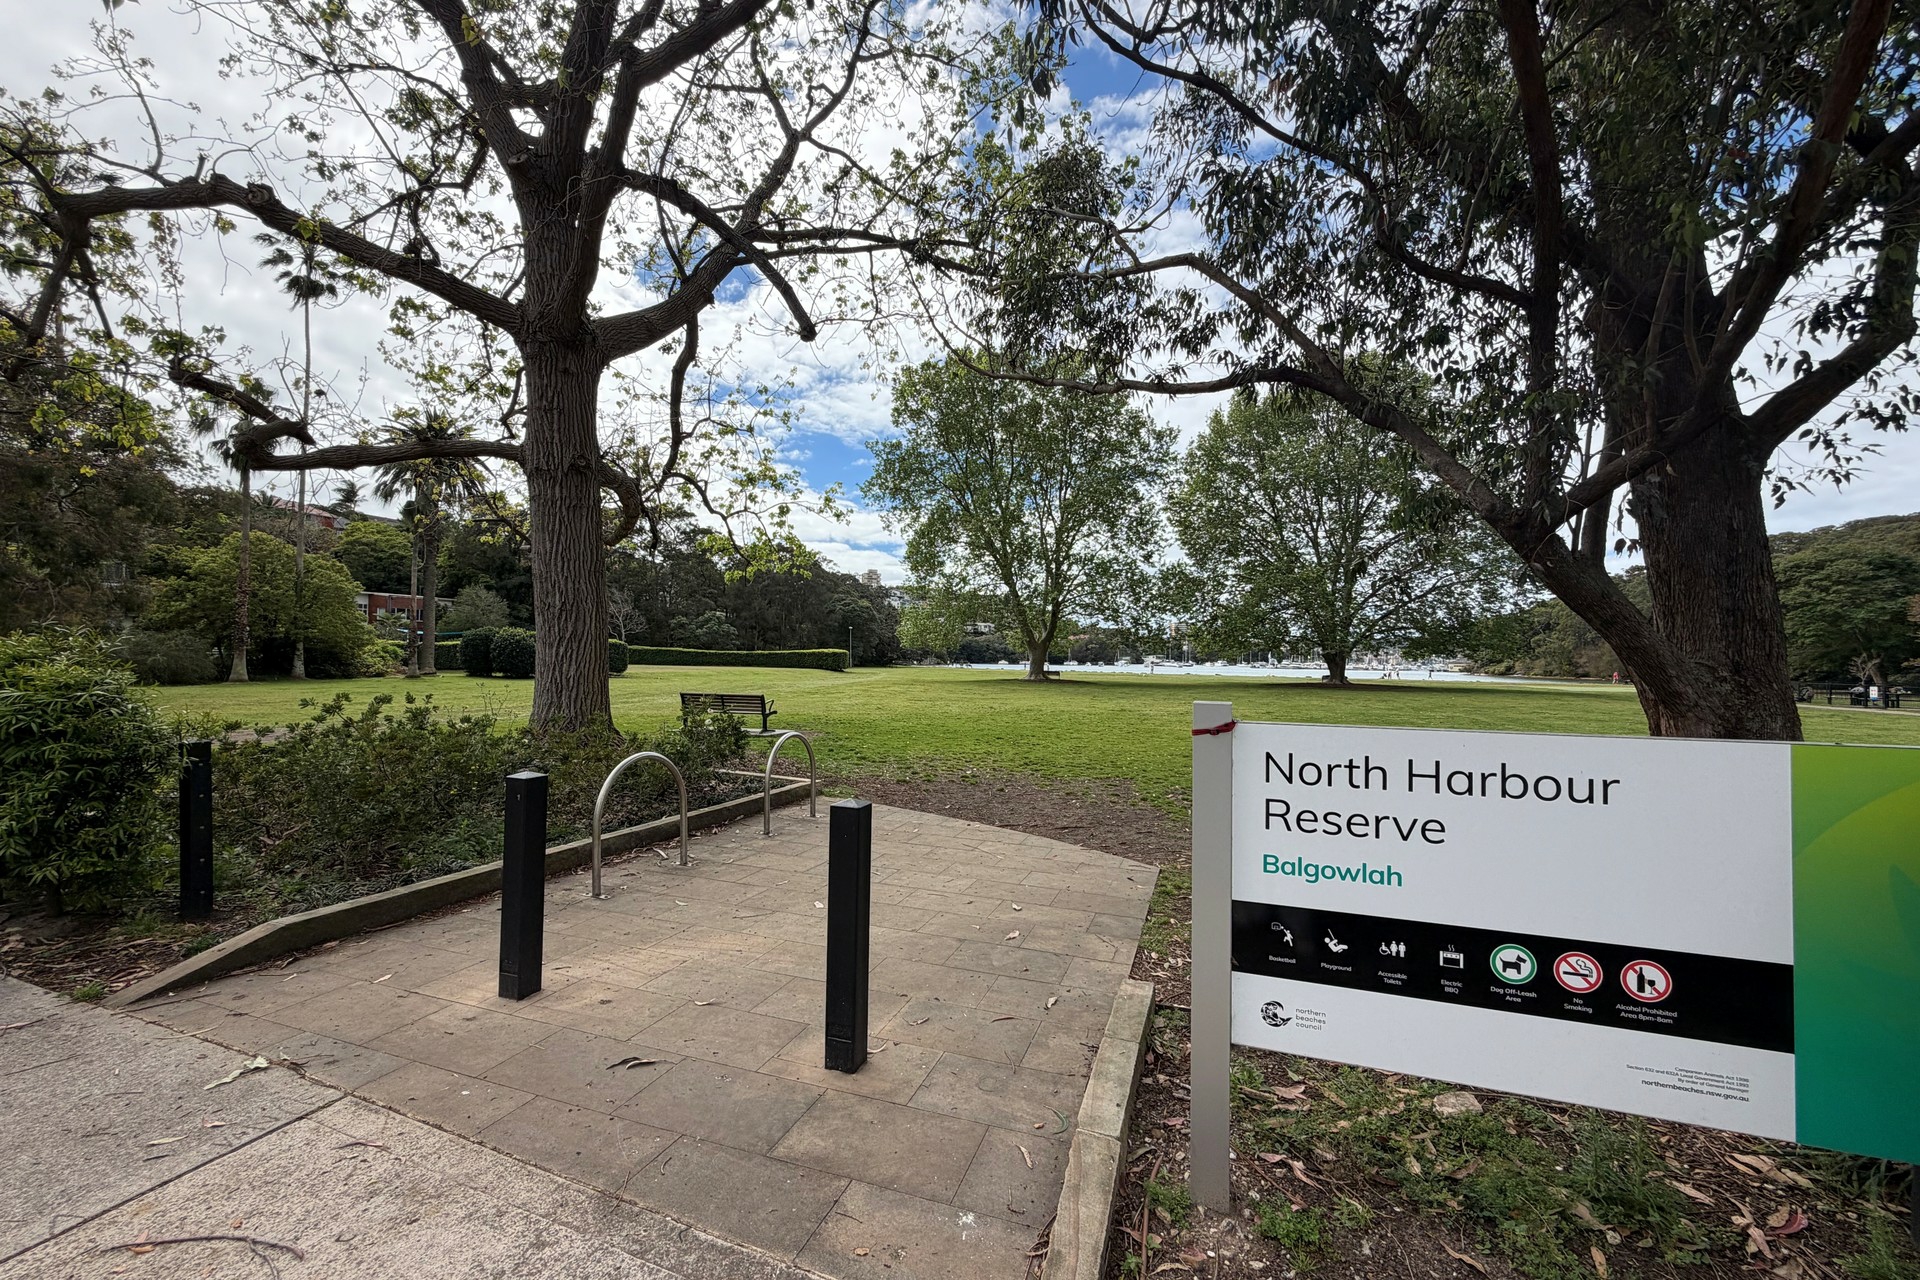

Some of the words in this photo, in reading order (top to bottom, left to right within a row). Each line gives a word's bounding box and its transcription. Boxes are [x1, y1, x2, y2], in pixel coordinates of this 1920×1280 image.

[1265, 751, 1388, 791] North
[1407, 758, 1621, 805] Harbour
[1265, 797, 1446, 845] Reserve
[1262, 854, 1403, 887] Balgowlah
[1268, 955, 1297, 964] Basketball
[1320, 962, 1352, 972] Playground
[1377, 970, 1408, 980] Accessible
[1383, 977, 1402, 985] Toilets
[1440, 979, 1463, 987] Electric
[1444, 986, 1459, 994] BBQ
[1490, 986, 1504, 994] Dog
[1505, 988, 1537, 998] Off-Leash
[1505, 995, 1522, 1003] Area
[1295, 1008, 1326, 1017] northern
[1563, 1003, 1593, 1014] Smoking
[1615, 1003, 1641, 1012] Alcohol
[1642, 1006, 1678, 1017] Prohibited
[1295, 1014, 1326, 1024] beaches
[1620, 1011, 1637, 1019] Area
[1638, 1014, 1673, 1024] 8pm-8am
[1295, 1022, 1322, 1031] council
[1694, 1075, 1724, 1084] Government
[1641, 1079, 1749, 1102] northernbeaches.nsw.gov.au
[1705, 1082, 1725, 1090] General
